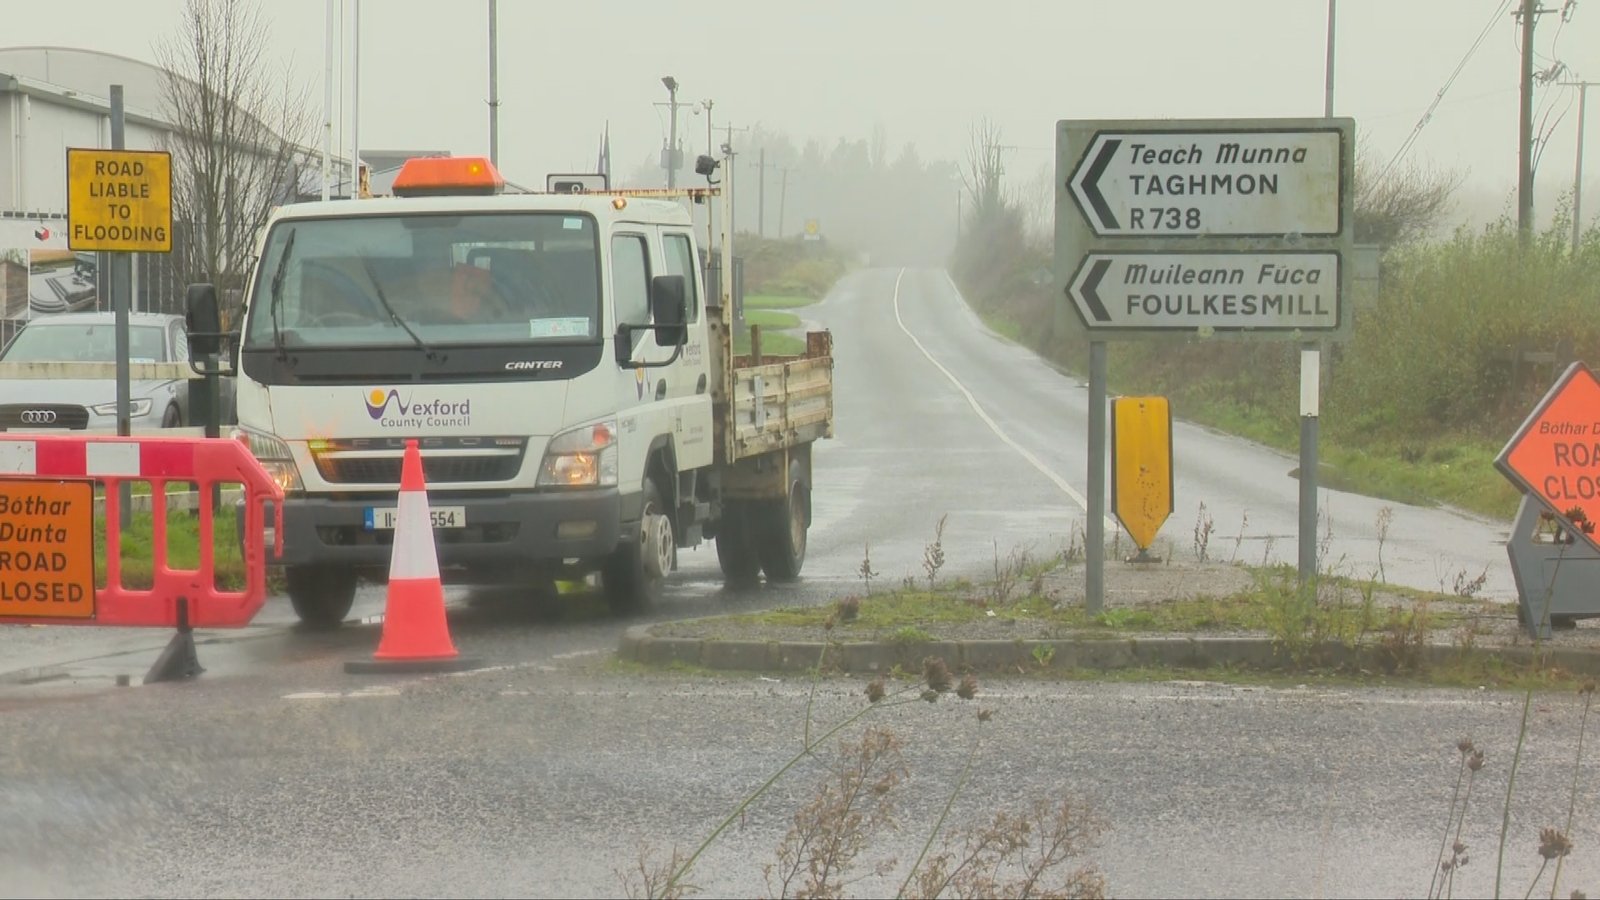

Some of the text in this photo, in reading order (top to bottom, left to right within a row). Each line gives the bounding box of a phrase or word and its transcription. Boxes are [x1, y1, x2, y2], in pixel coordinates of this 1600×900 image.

[1129, 143, 1307, 164] Teach Munna
[95, 161, 144, 176] ROAD
[90, 182, 149, 198] LIABLE
[1129, 174, 1278, 195] TAGHMON
[108, 204, 131, 219] TO
[74, 225, 166, 242] FLOODING
[1123, 264, 1320, 284] Muileann Fúca
[1127, 295, 1328, 315] FOULKESMILL
[505, 360, 563, 370] CANTER
[381, 416, 471, 429] County Council
[1553, 442, 1600, 467] ROA
[1544, 475, 1600, 500] CLO
[0, 523, 67, 542] Dúnta
[0, 551, 67, 571] ROAD
[0, 582, 83, 602] LOSED
